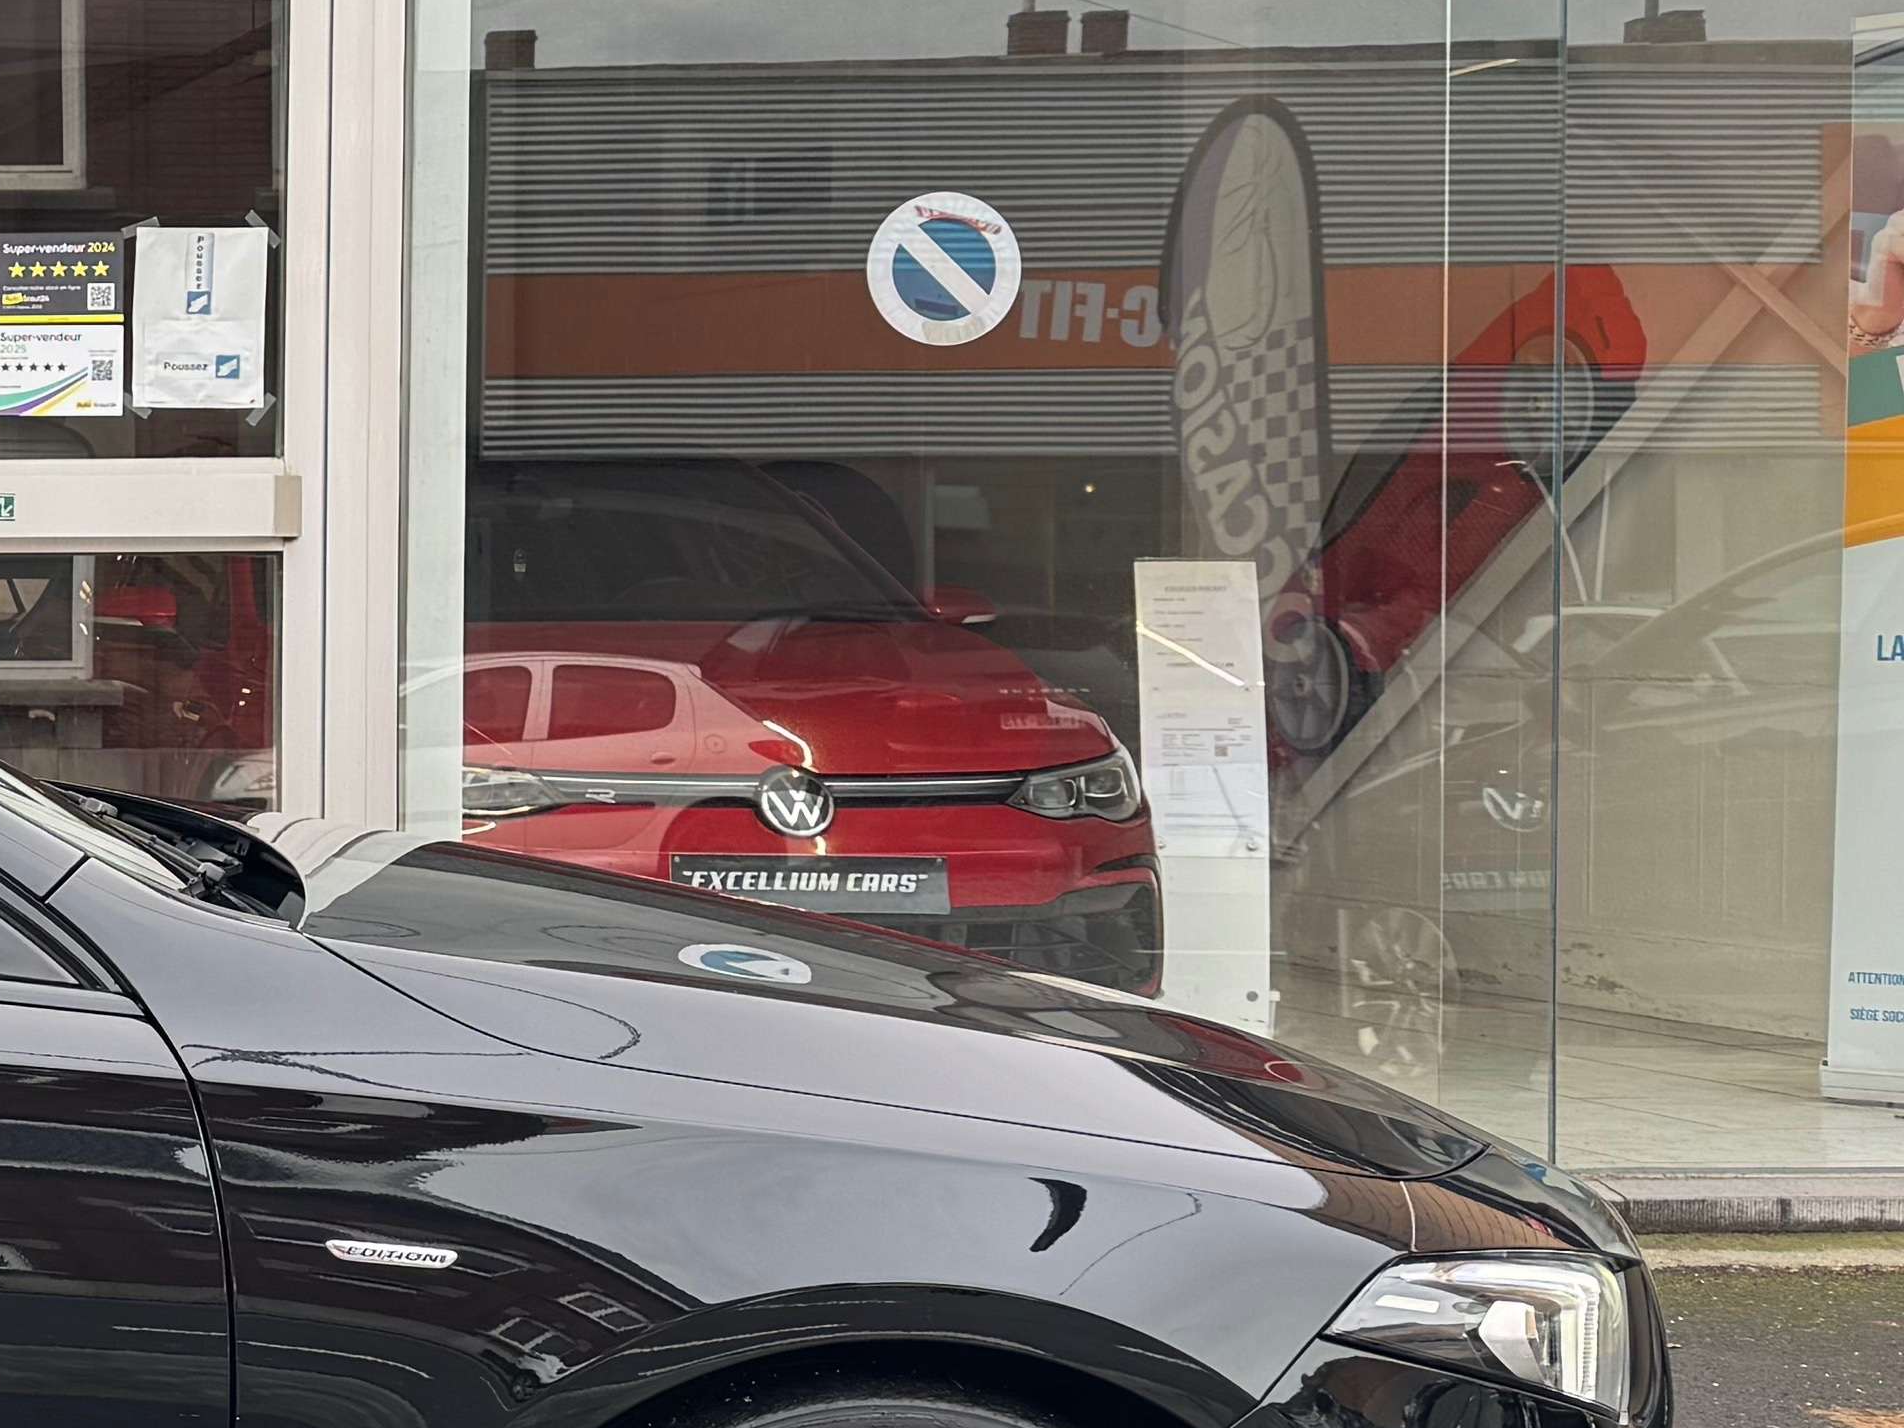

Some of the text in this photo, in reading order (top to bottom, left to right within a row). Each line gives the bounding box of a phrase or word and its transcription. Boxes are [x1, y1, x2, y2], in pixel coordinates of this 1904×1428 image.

[2, 241, 115, 256] Super-vendeur 2024
[691, 871, 920, 893] EXCELLIUM CARS
